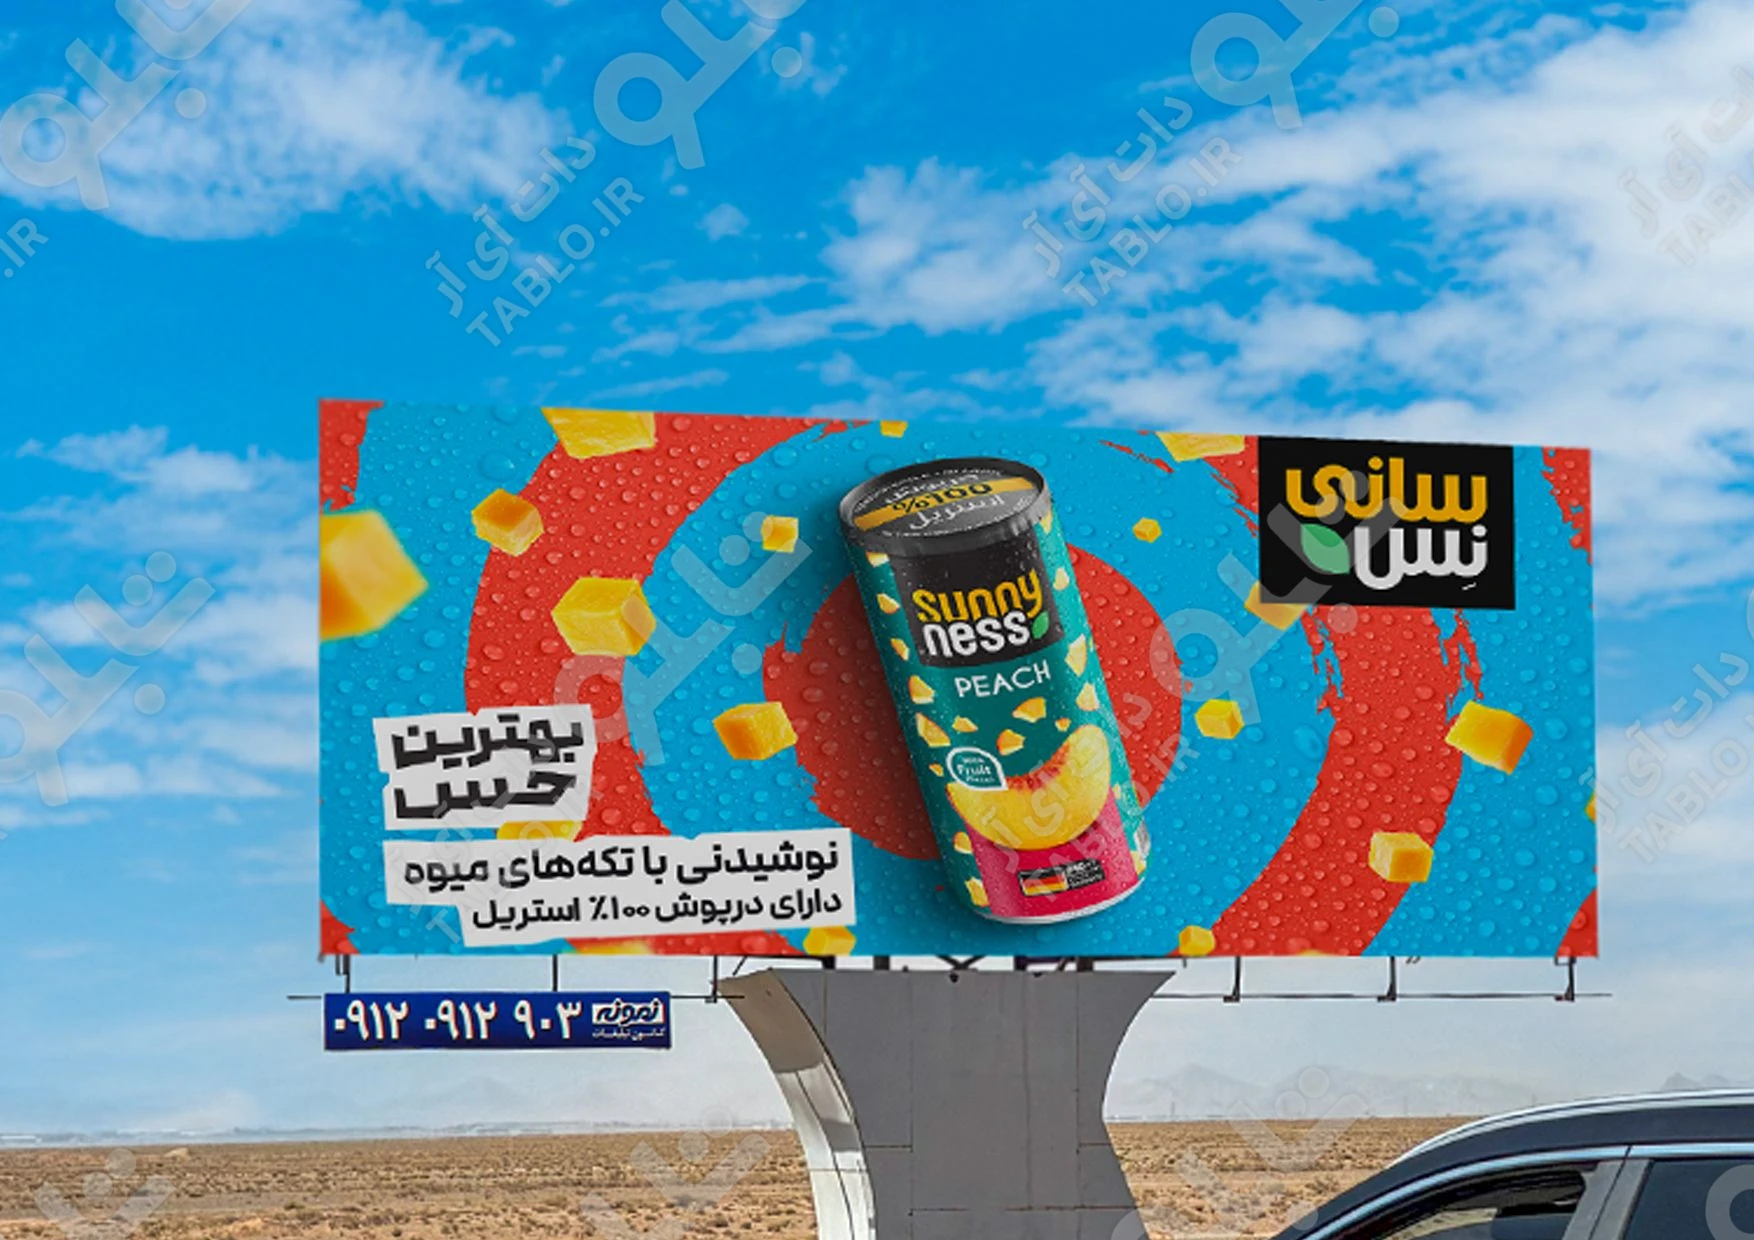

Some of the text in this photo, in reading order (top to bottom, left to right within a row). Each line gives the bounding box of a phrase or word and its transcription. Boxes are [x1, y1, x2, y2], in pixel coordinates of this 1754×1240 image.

[1285, 456, 1488, 524] سانی
[923, 610, 1030, 658] ness
[954, 660, 1051, 698] PEACH
[392, 713, 584, 769] بهترین
[394, 771, 577, 819] حس
[405, 856, 489, 892] میوه
[643, 845, 668, 884] با
[676, 841, 839, 884] نوشیدنی
[472, 898, 579, 931] استریل
[655, 892, 763, 926] درپوش
[770, 889, 842, 919] دارای
[335, 999, 582, 1040] ۰۹۱۲ ۰۹۱۲ ۹۰۳
